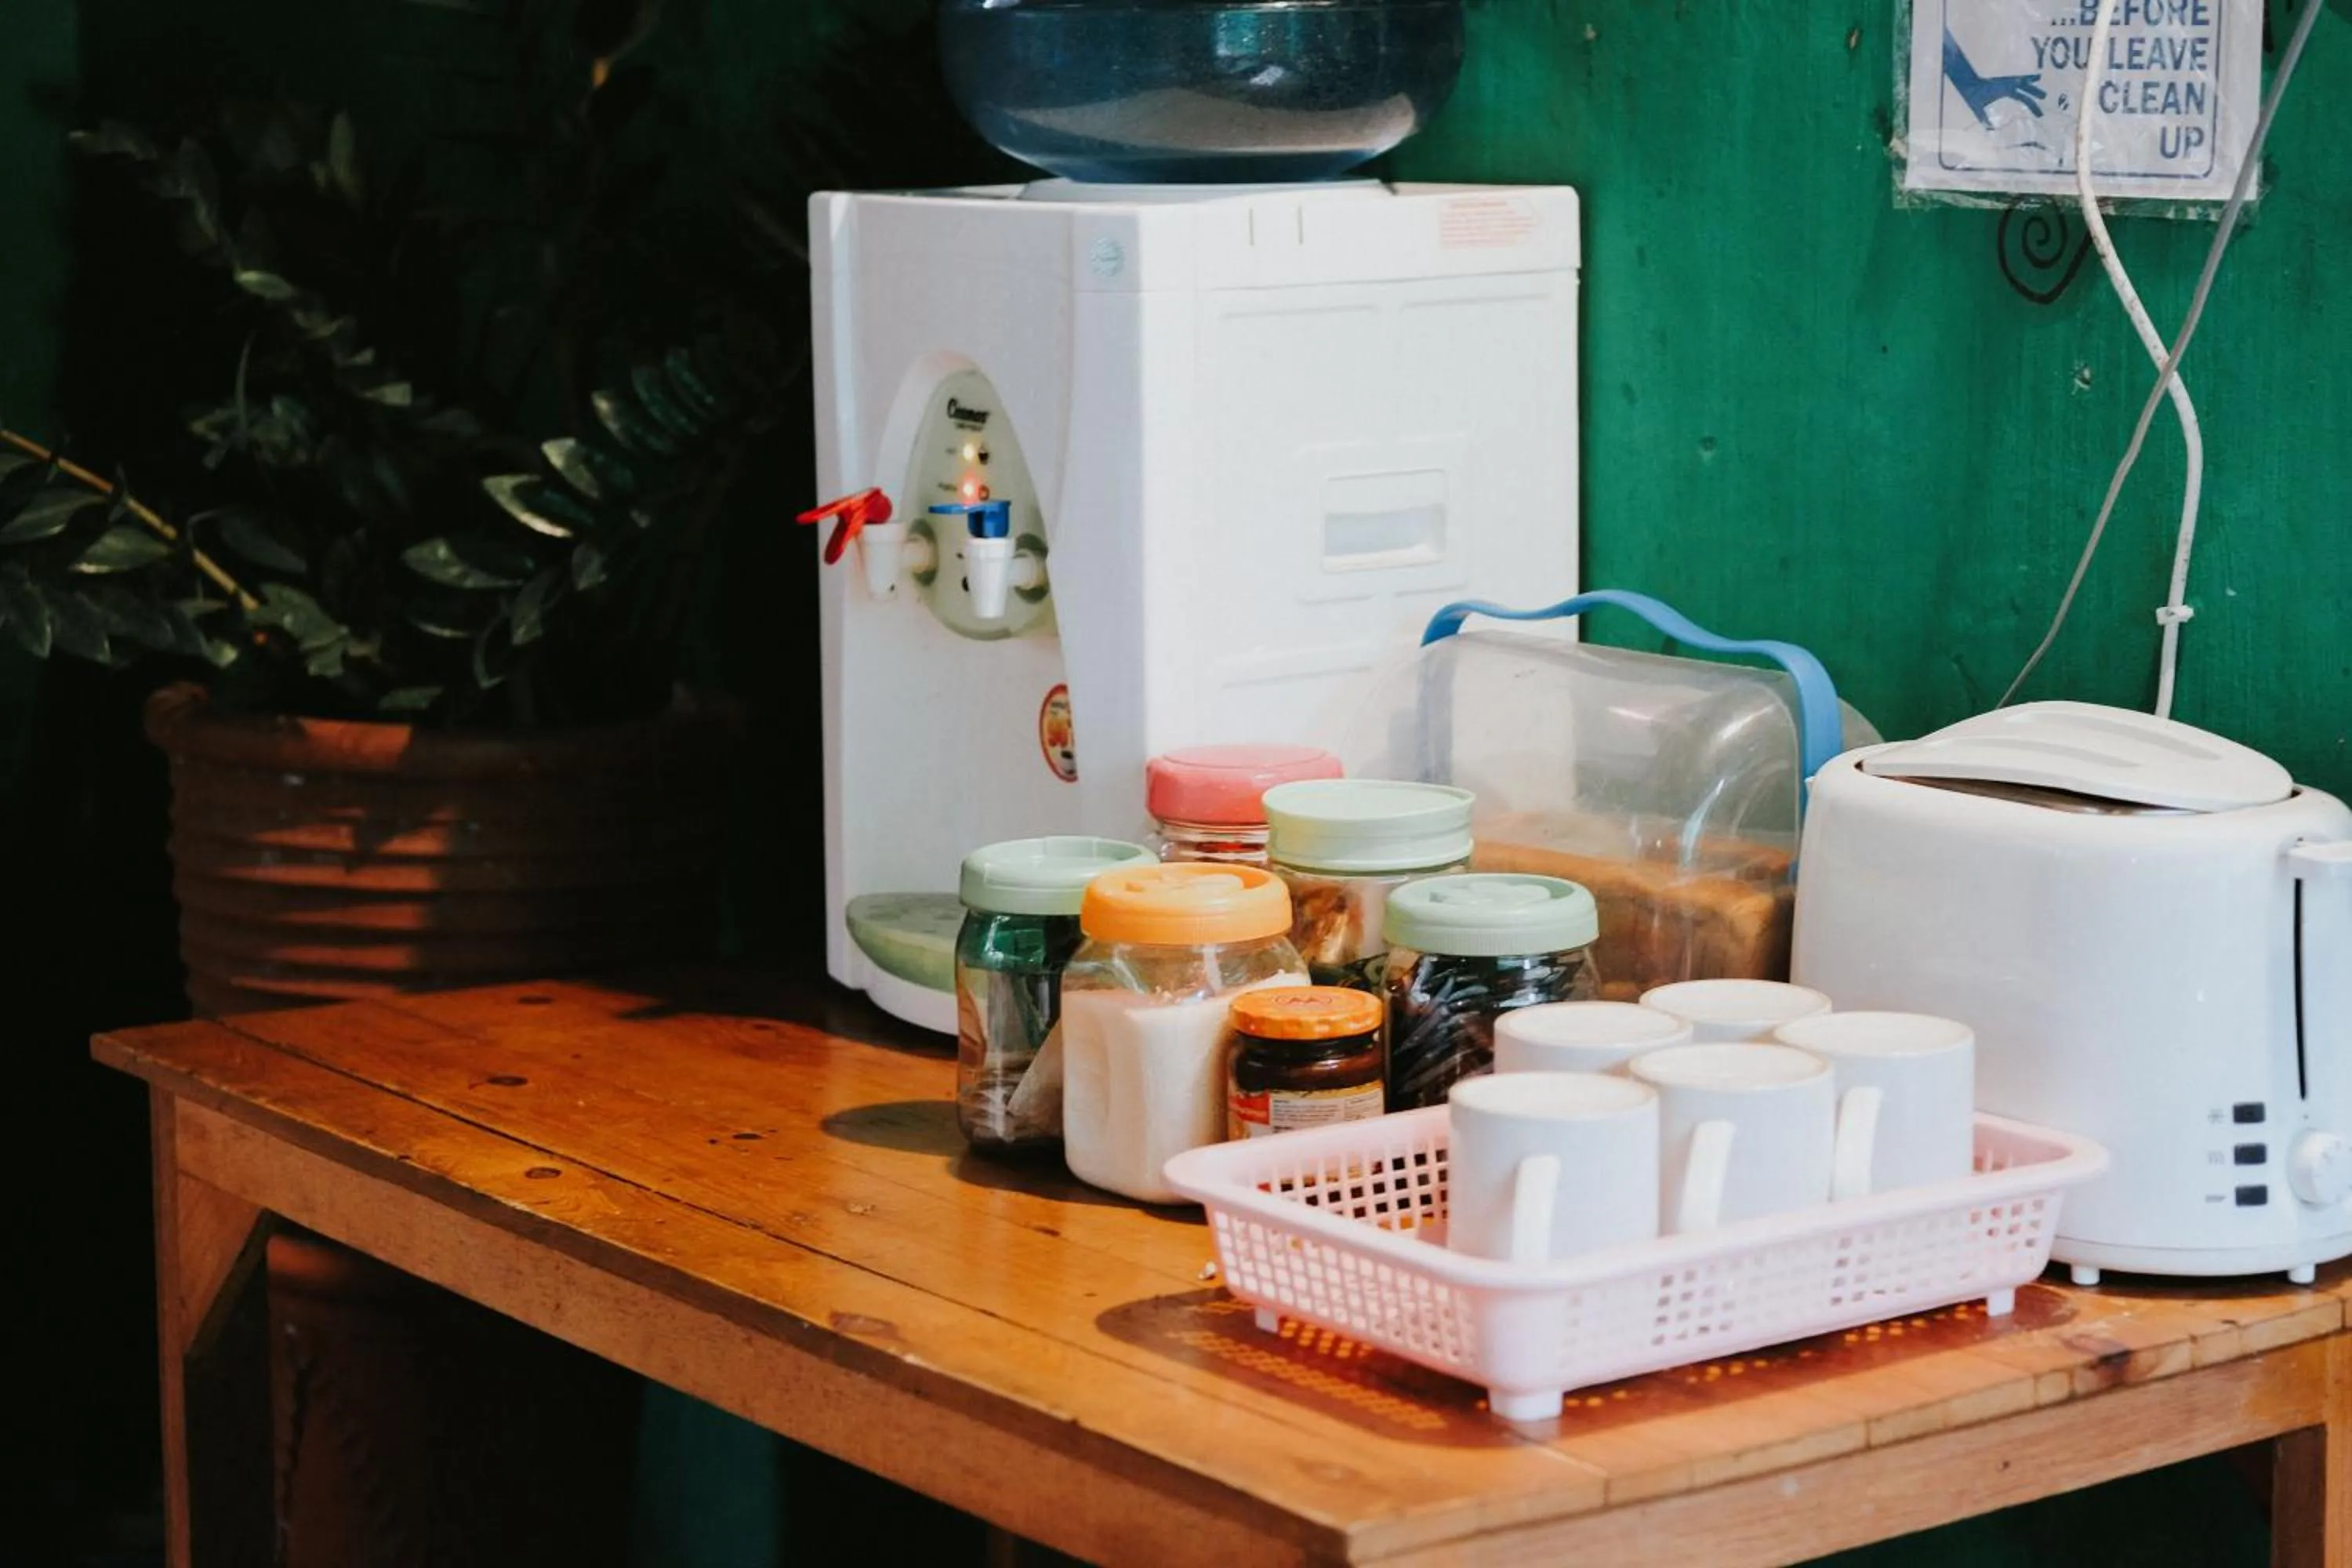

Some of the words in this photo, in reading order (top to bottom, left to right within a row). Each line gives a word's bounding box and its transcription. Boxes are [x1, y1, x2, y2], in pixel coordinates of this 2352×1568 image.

[2031, 36, 2092, 70] YOU
[2108, 37, 2209, 71] LEAVE
[2099, 80, 2205, 114] CLEAN
[2160, 125, 2205, 159] UP
